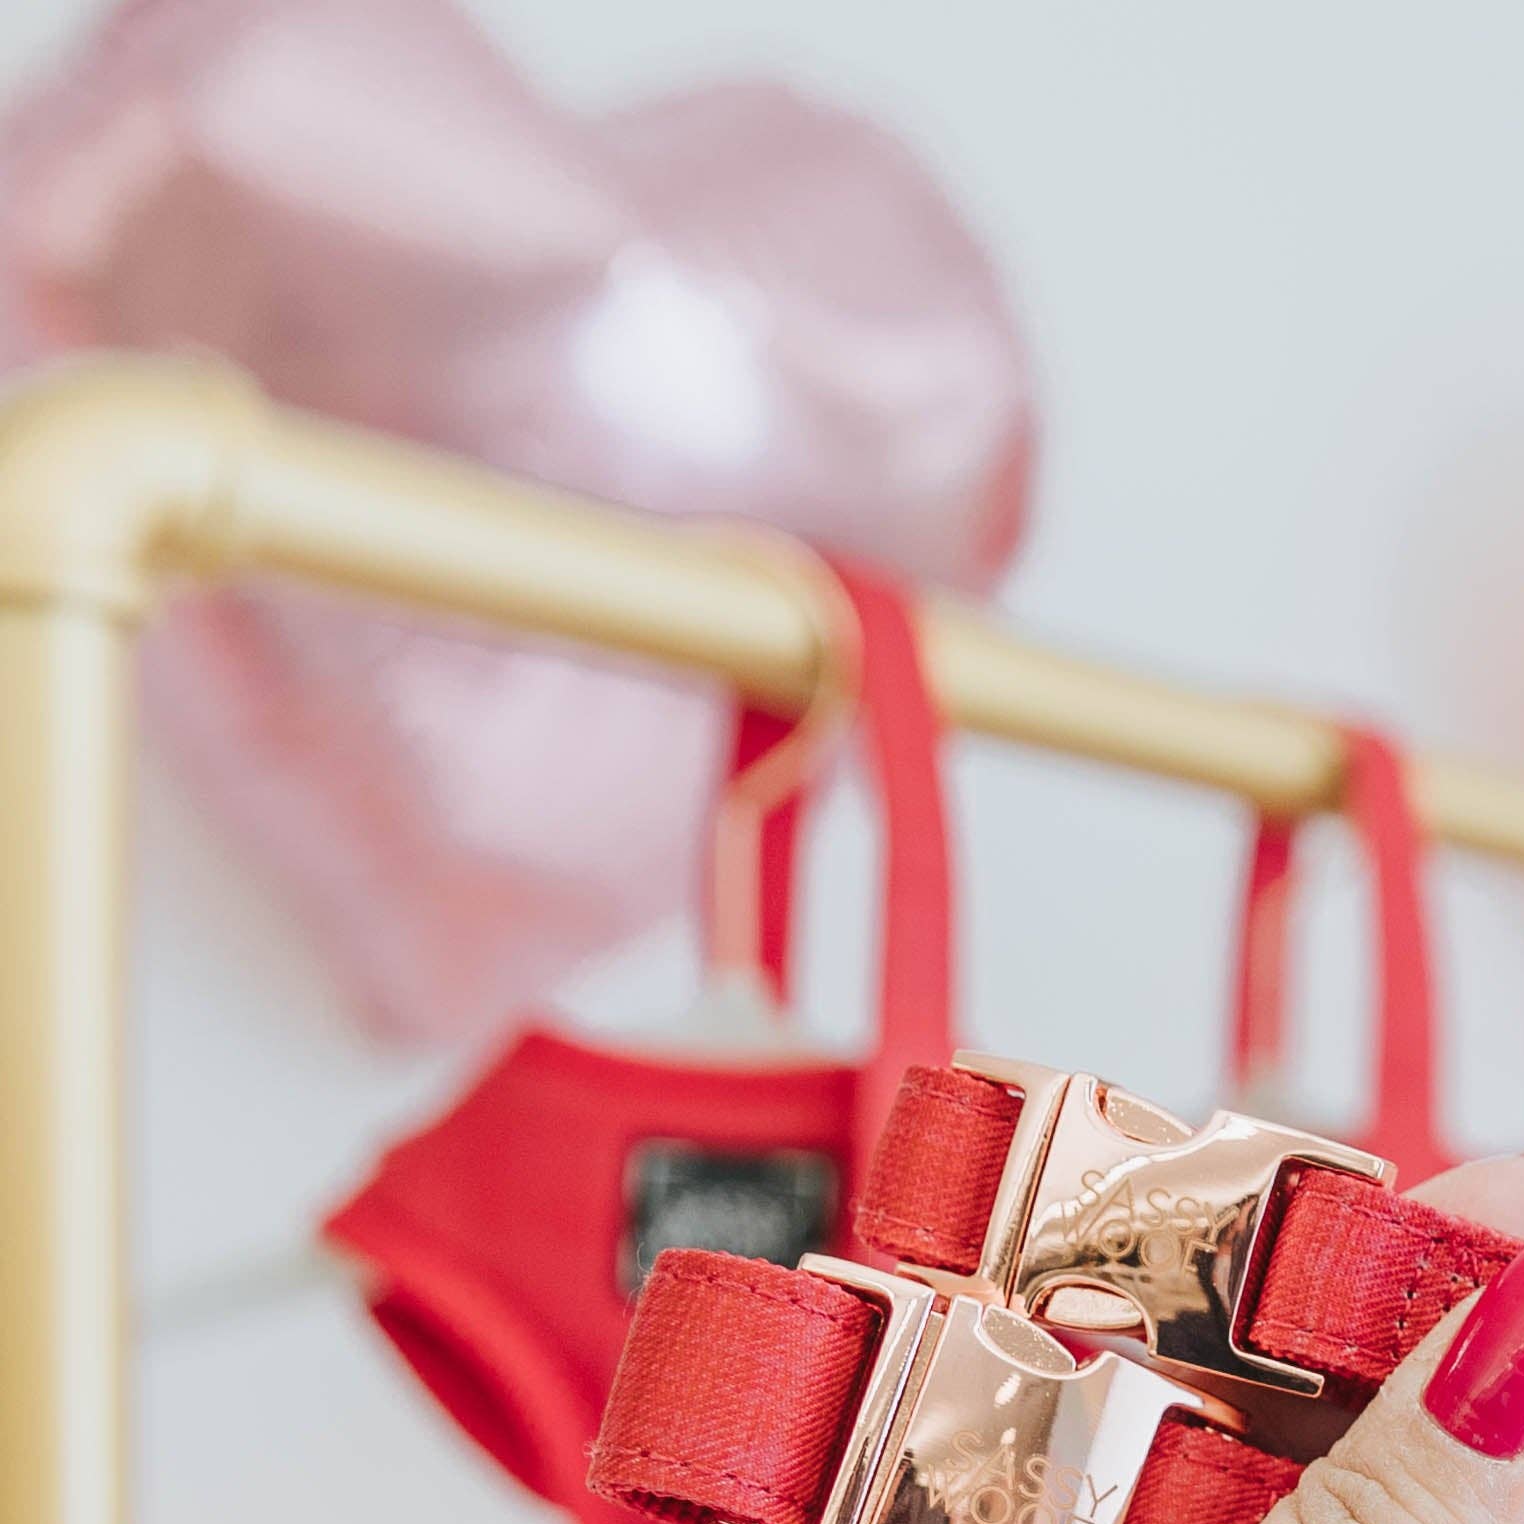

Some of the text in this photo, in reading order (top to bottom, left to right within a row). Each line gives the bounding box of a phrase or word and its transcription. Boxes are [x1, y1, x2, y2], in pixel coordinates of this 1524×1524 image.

[1061, 1201, 1218, 1274] WOOF
[1076, 1169, 1241, 1246] SASSY
[945, 1429, 1119, 1519] SASSY
